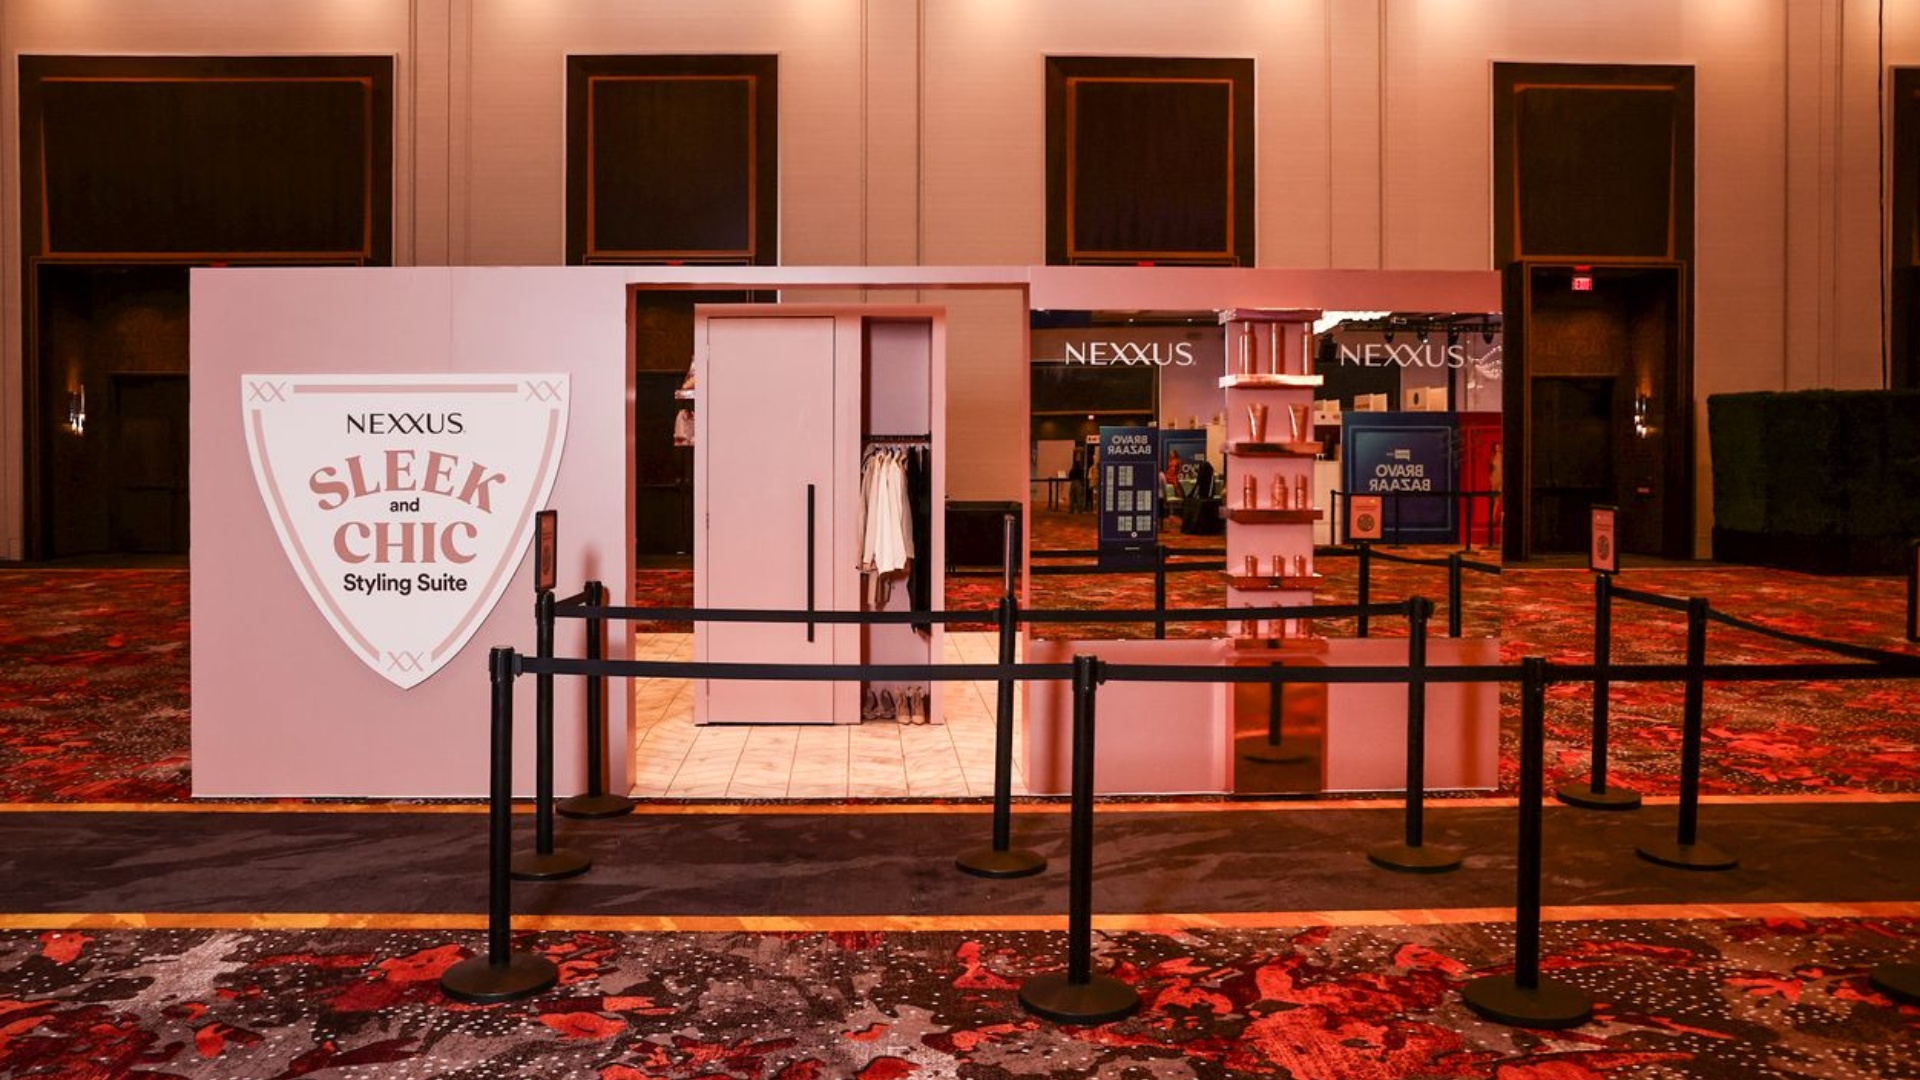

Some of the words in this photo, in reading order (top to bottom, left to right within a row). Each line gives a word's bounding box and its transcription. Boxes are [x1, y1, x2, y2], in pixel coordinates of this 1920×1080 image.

[1065, 341, 1193, 366] NEXXUS
[1340, 343, 1465, 369] NEXXUS
[346, 413, 464, 435] NEXXUS
[309, 449, 506, 514] SLEEK
[389, 497, 420, 512] and
[333, 521, 478, 564] CHIC
[343, 573, 412, 595] Styling
[417, 573, 468, 591] Suite
